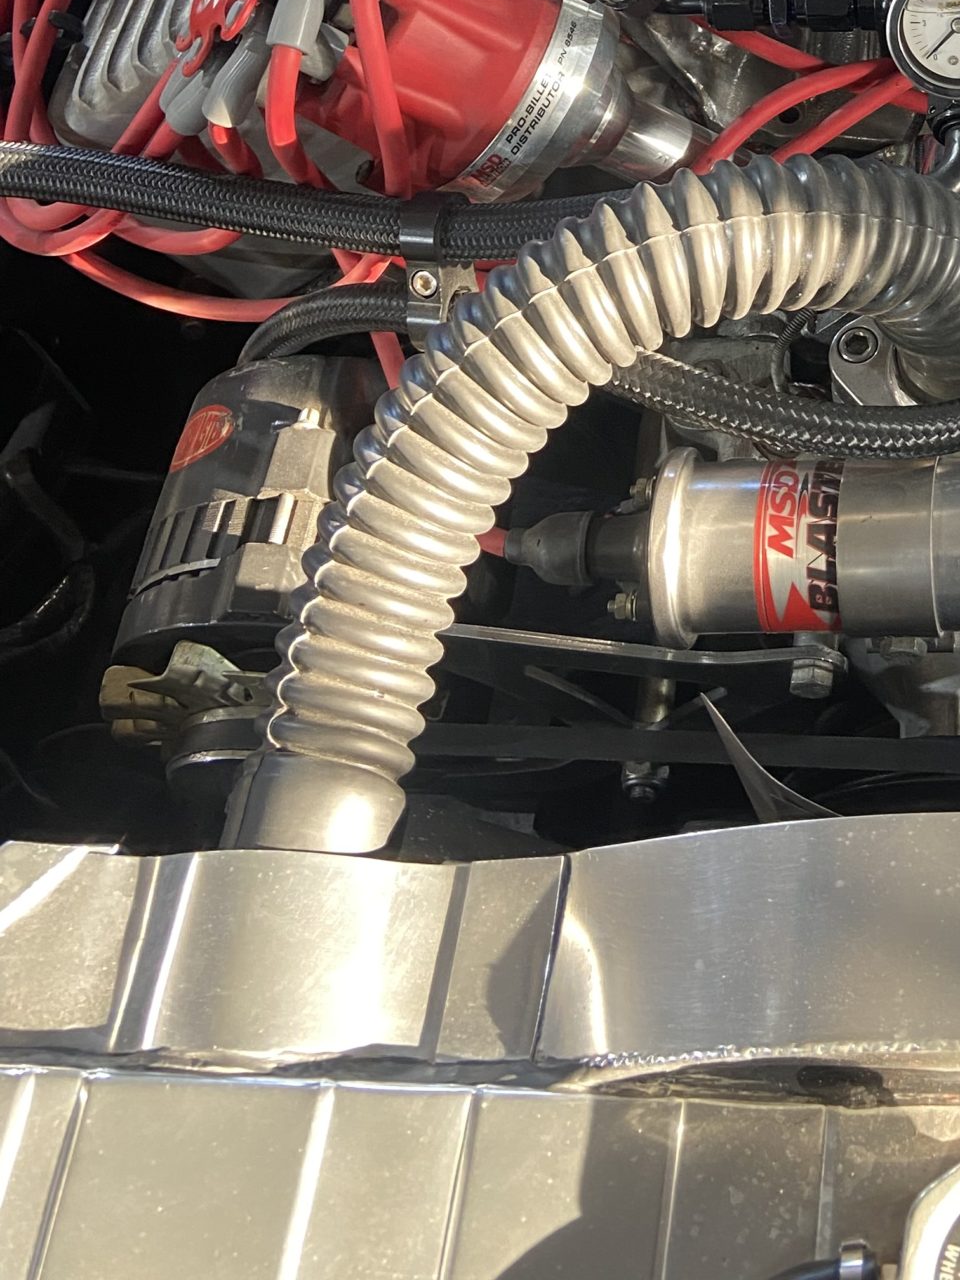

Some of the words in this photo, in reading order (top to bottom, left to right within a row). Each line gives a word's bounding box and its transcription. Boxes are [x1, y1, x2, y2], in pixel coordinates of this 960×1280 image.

[557, 49, 567, 66] PN
[505, 72, 552, 145] PRO-BILLE
[768, 470, 799, 558] MSD
